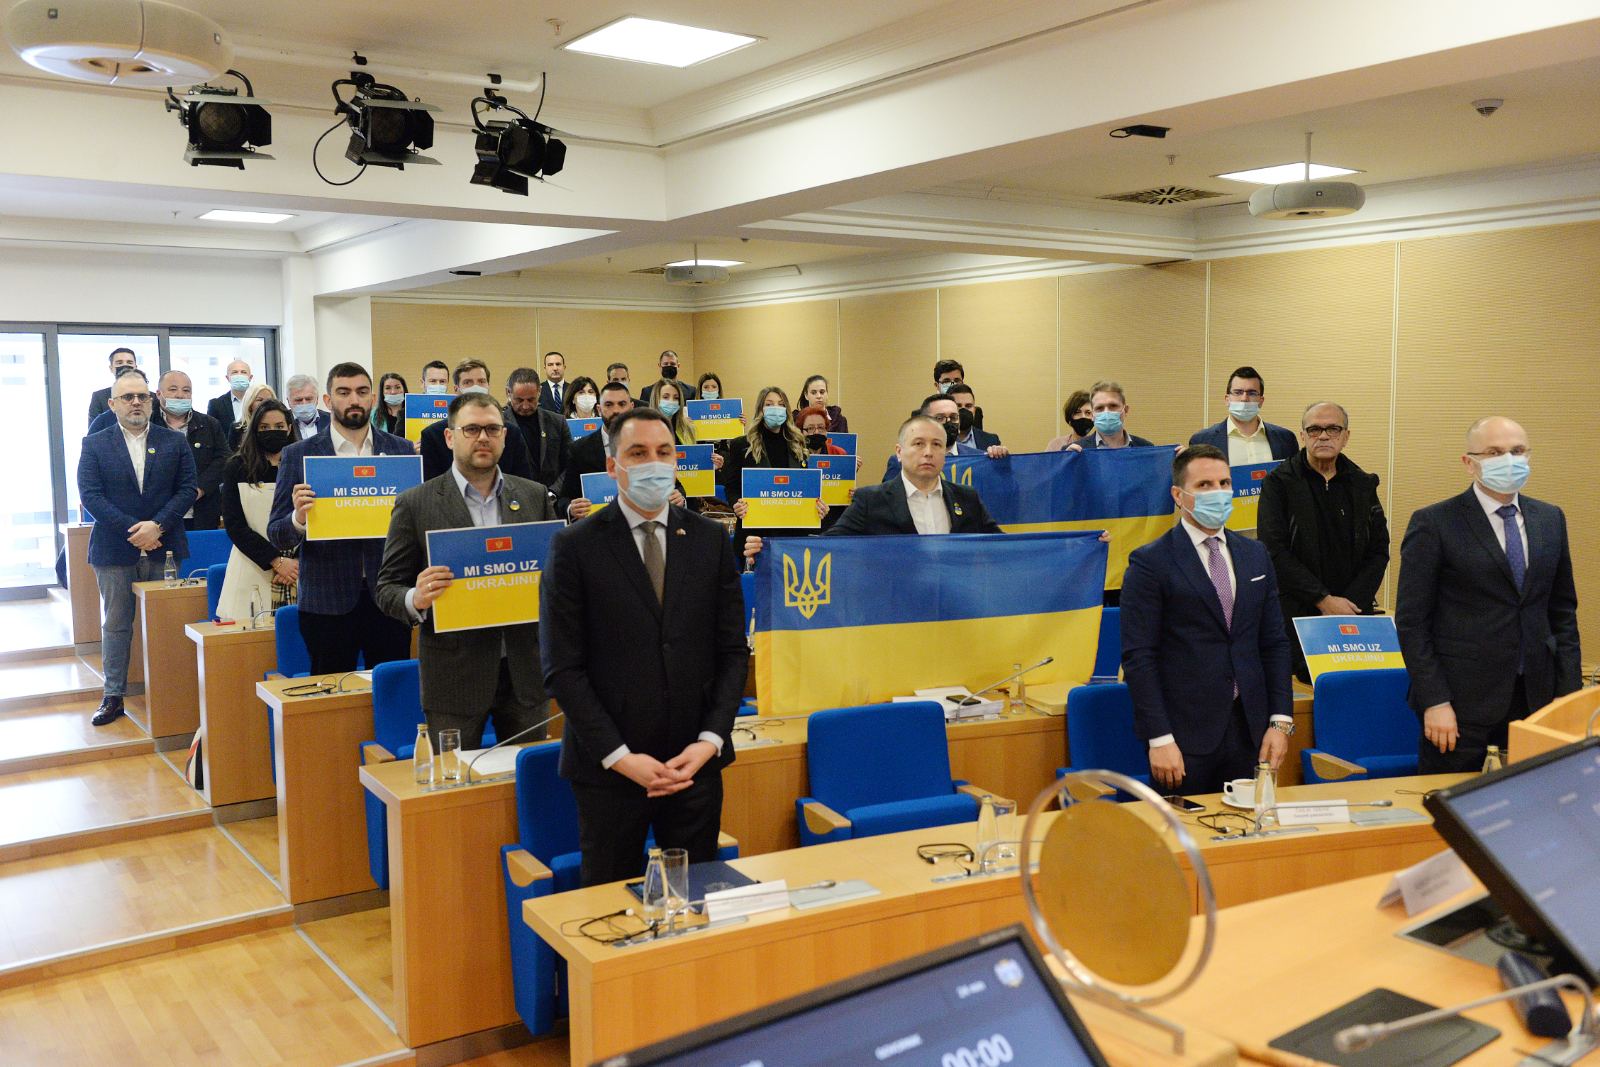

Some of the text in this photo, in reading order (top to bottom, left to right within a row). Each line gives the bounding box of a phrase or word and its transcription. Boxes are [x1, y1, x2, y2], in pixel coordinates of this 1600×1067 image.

[333, 486, 397, 497] MI SMO UZ
[760, 490, 803, 498] MI SMO UZ
[1239, 489, 1249, 497] MI
[463, 559, 539, 577] MI SMO UZ
[466, 574, 539, 591] UKRAJINU
[1327, 643, 1382, 653] MI SMO UZ
